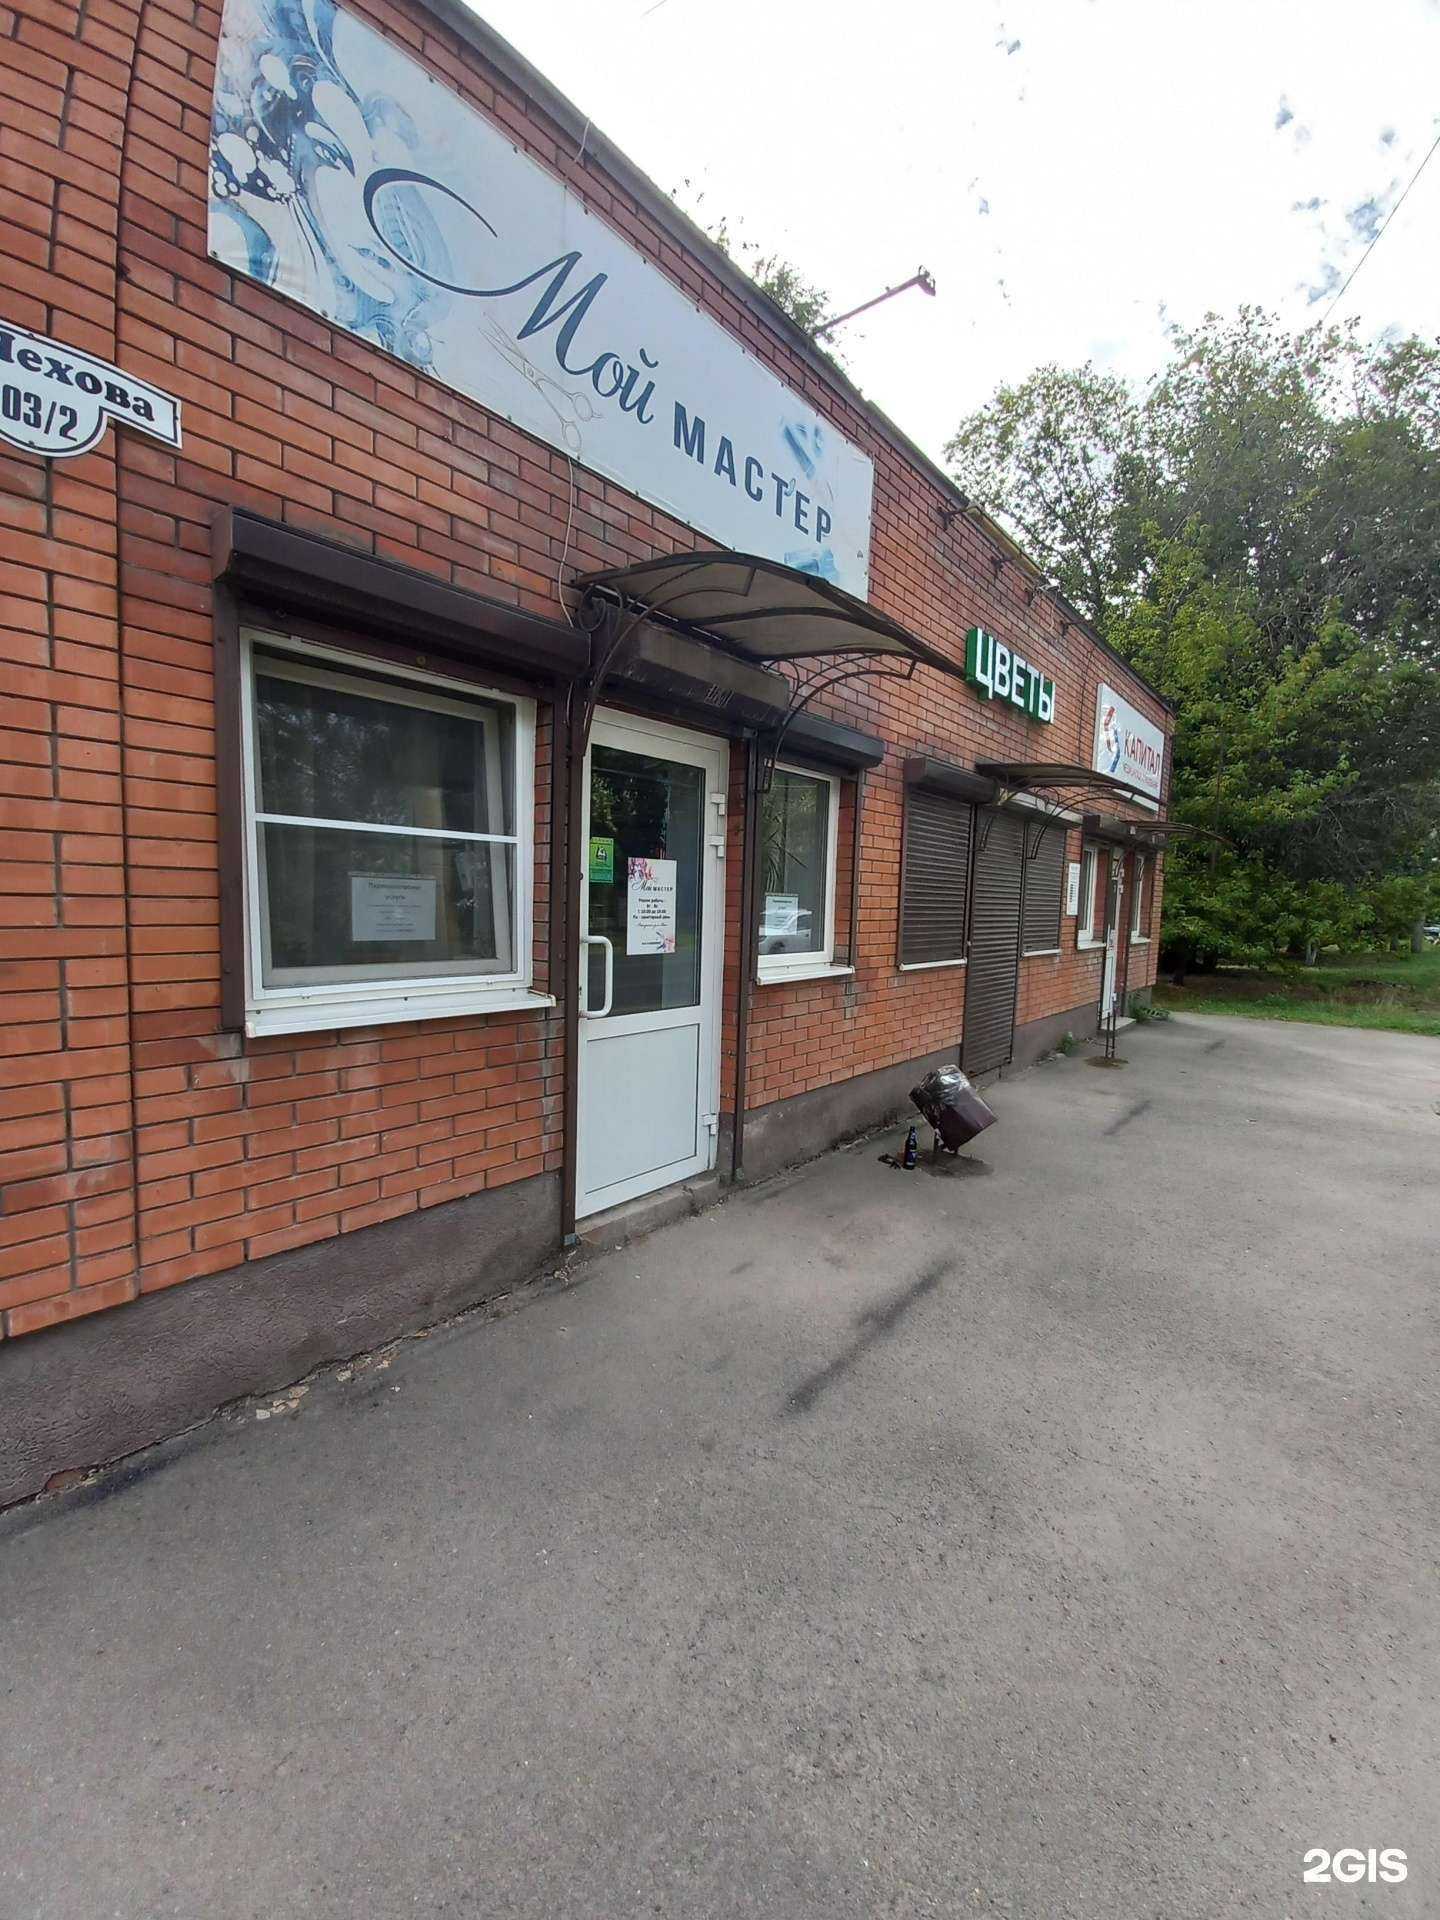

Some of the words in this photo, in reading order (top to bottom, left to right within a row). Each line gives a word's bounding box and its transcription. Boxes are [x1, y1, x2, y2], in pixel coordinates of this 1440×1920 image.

[363, 168, 659, 424] Мой
[673, 400, 832, 543] МАСТЕР
[975, 627, 1056, 724] ЦВЕТЫ
[1124, 728, 1160, 777] КАПИТАЛ
